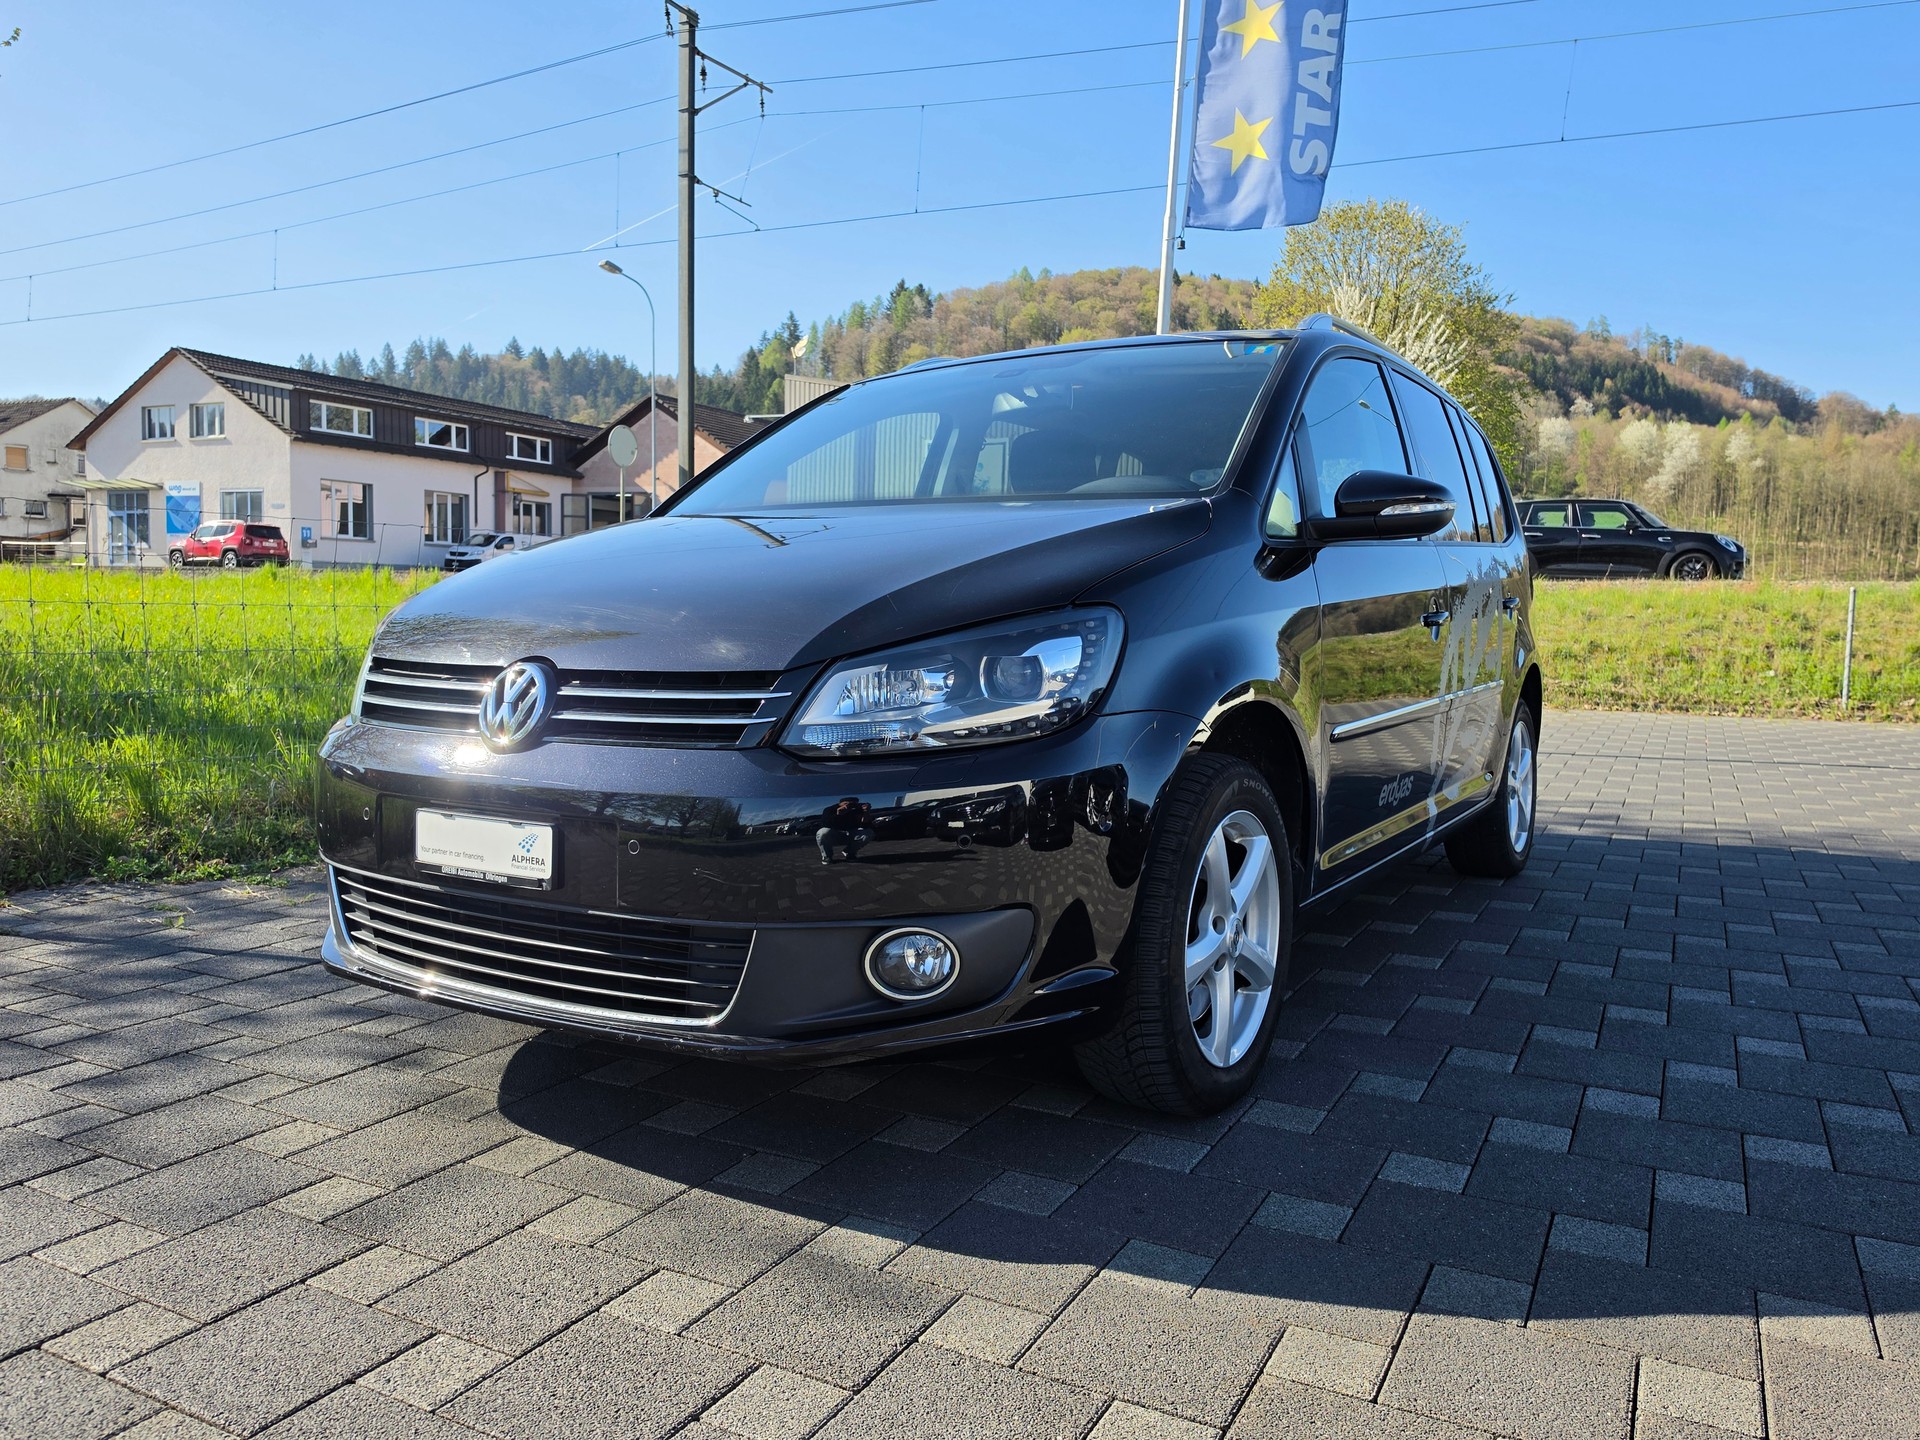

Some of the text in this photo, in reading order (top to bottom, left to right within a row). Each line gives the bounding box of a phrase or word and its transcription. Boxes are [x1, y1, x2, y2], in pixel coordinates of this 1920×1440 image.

[1289, 8, 1342, 175] STAR
[303, 529, 311, 538] 11
[420, 845, 431, 853] Your
[431, 848, 448, 856] partner
[462, 851, 486, 862] financing.
[511, 854, 546, 867] ALPHERA
[458, 868, 484, 879] Automobile
[511, 863, 546, 873] Financial Services
